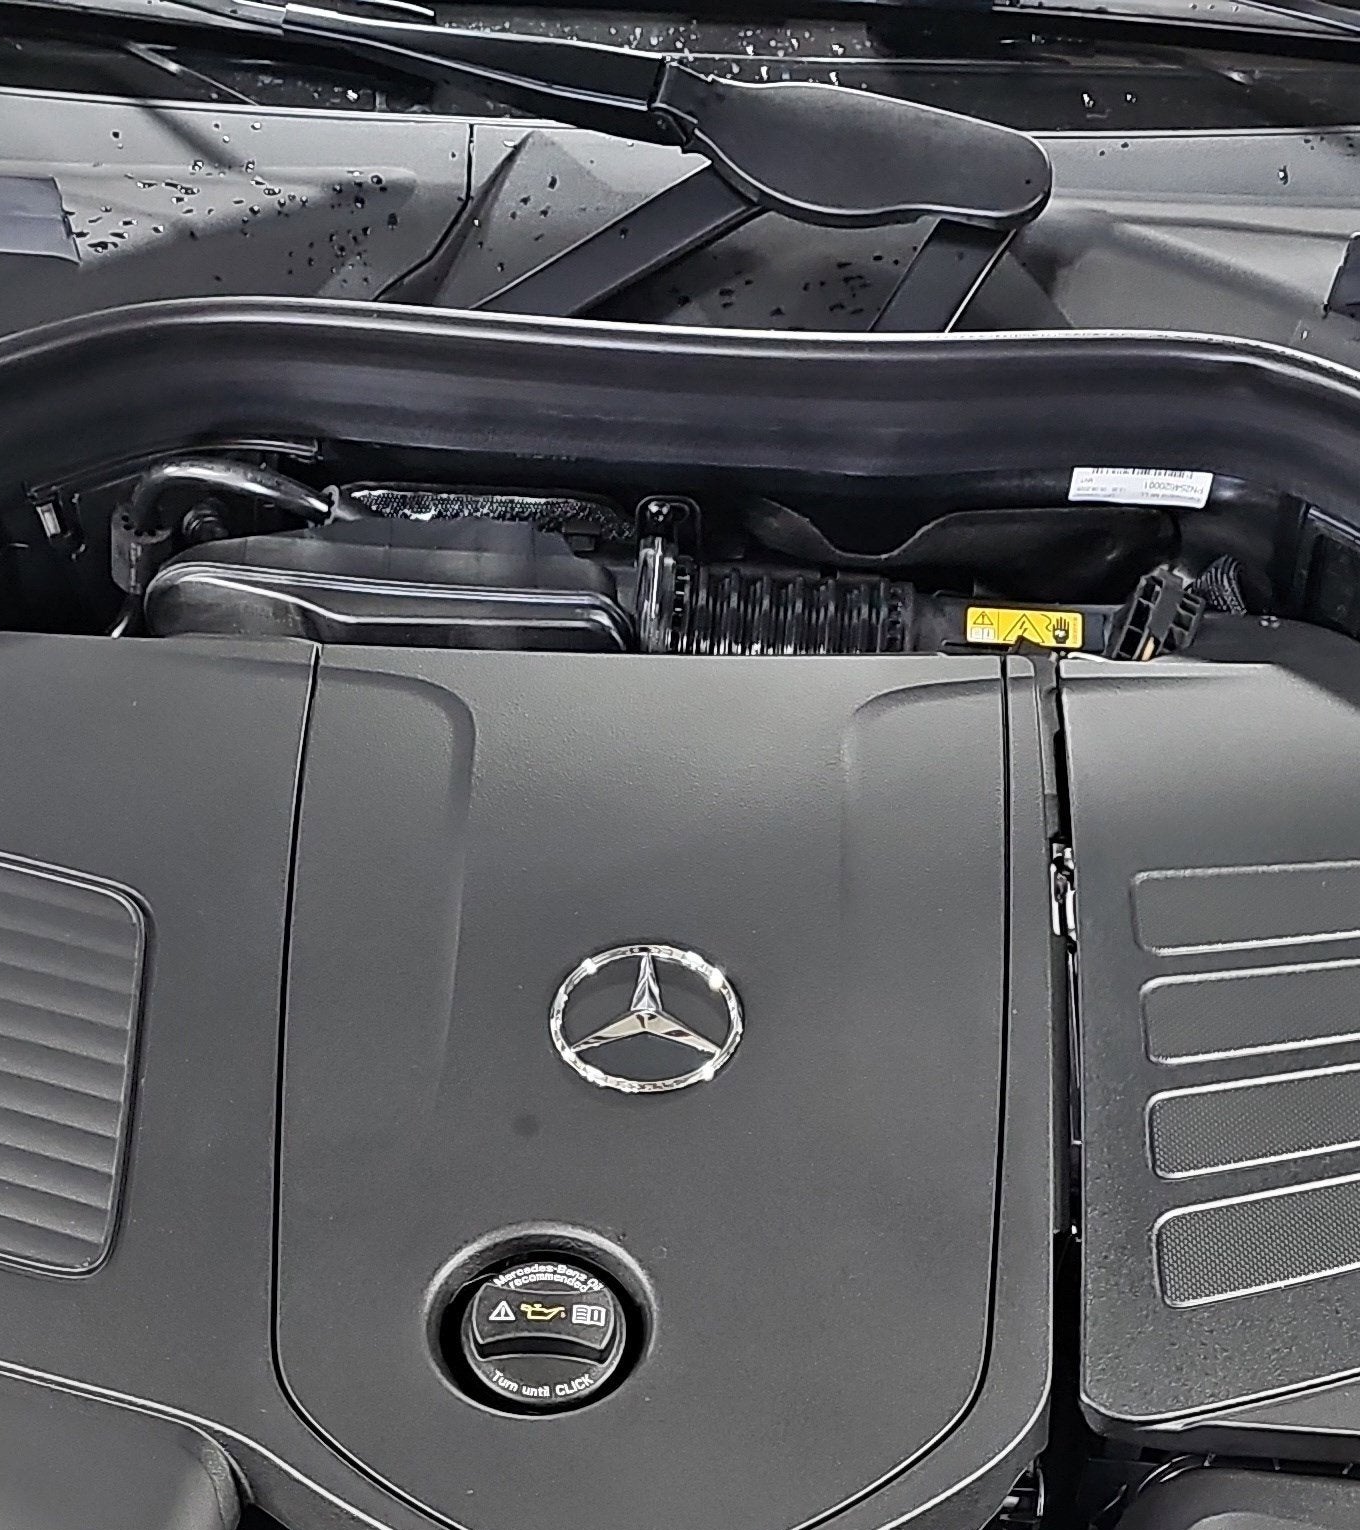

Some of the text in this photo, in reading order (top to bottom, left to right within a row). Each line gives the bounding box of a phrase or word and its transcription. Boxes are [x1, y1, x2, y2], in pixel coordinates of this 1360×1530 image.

[493, 1264, 587, 1287] Mercedes-Benz
[509, 1273, 590, 1293] recommended
[492, 1369, 594, 1397] Turn until CLICK
